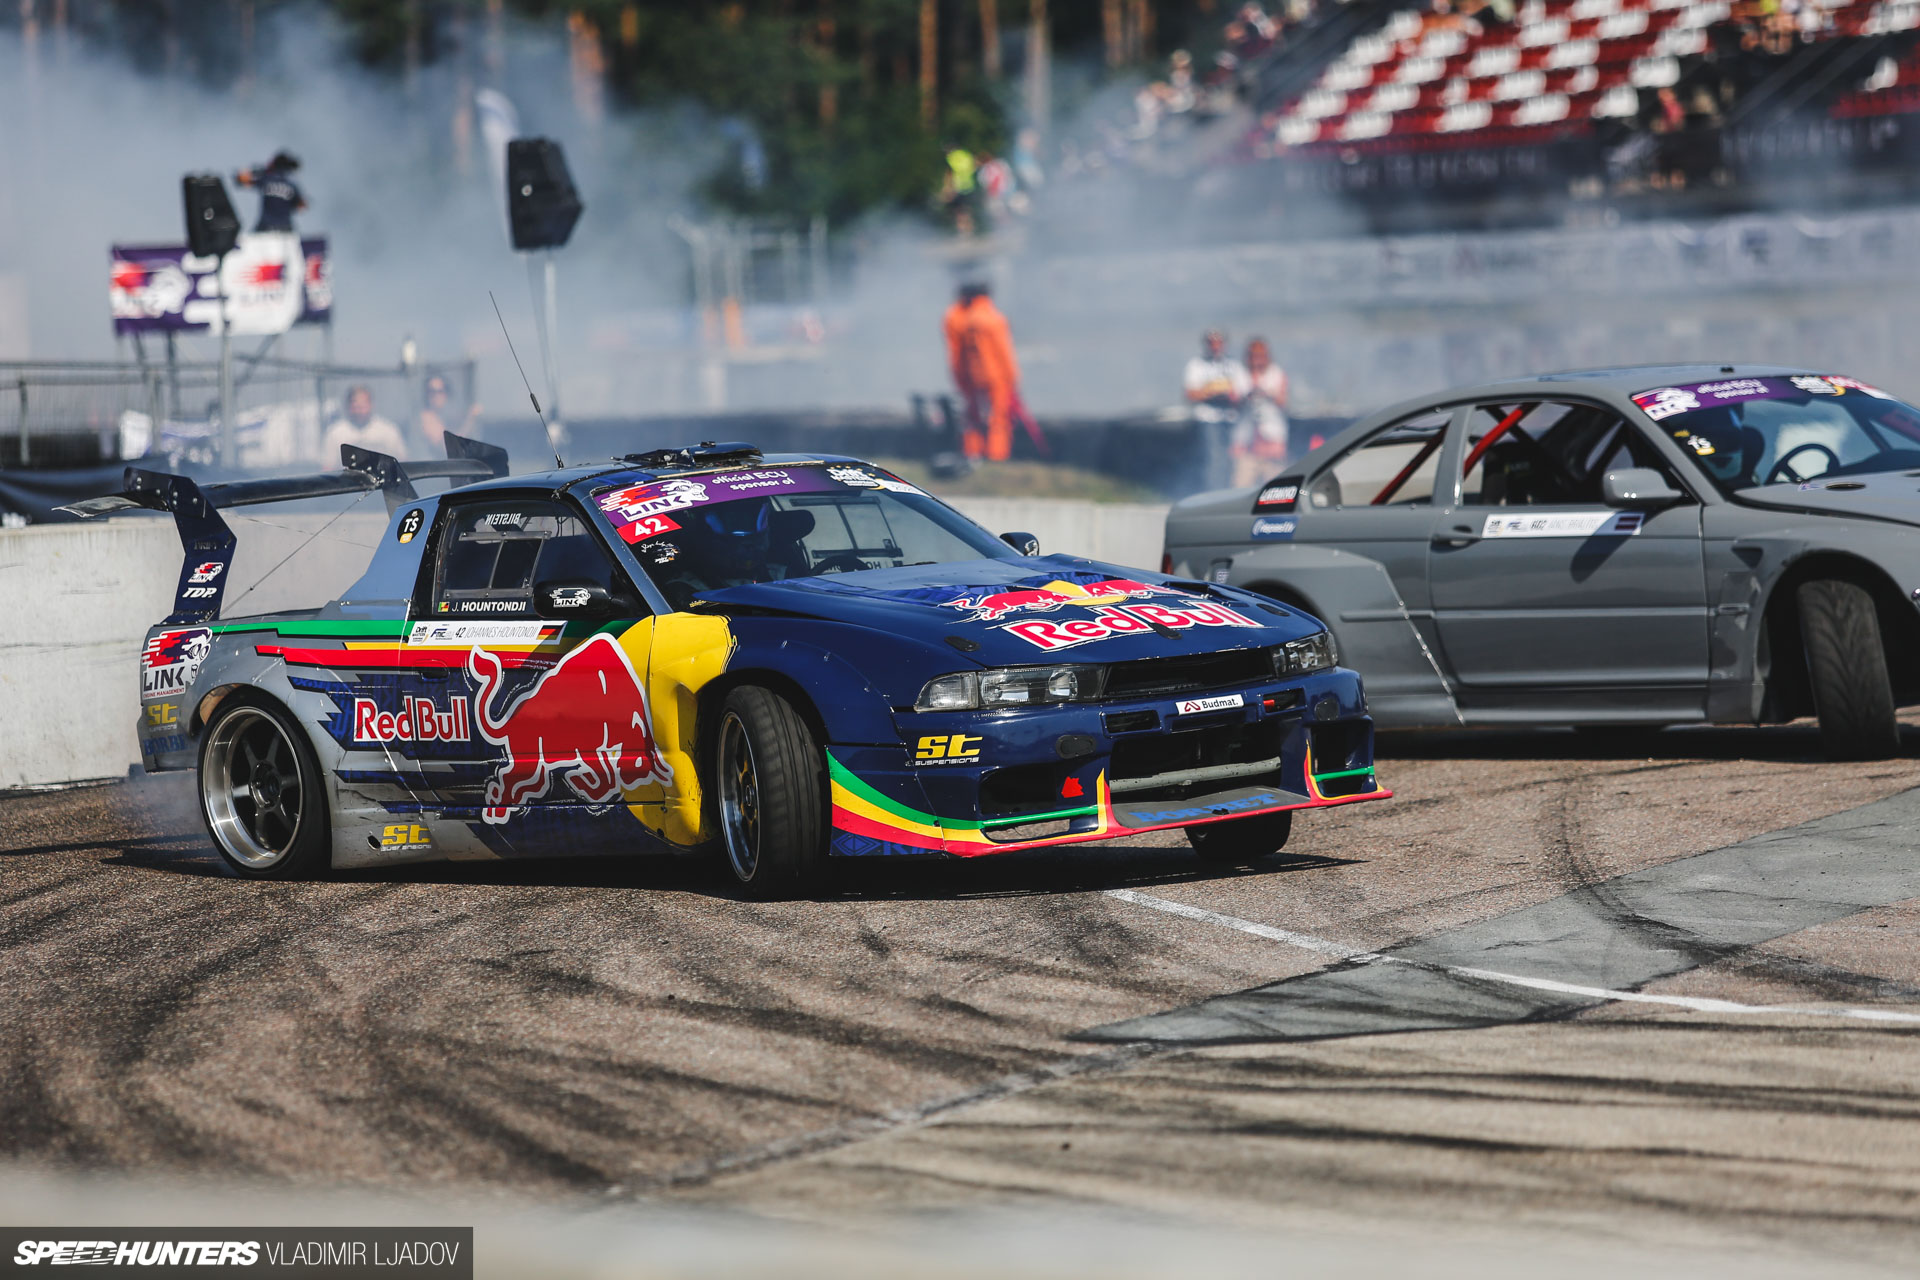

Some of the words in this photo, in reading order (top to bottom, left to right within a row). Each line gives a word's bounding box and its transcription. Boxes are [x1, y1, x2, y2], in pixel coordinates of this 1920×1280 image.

[712, 473, 755, 485] official
[756, 470, 789, 480] ECU
[730, 480, 780, 491] sponsor
[782, 477, 796, 486] of
[621, 495, 683, 519] LINK
[403, 517, 420, 533] TS
[634, 517, 669, 537] 42
[452, 602, 460, 612] J.
[461, 600, 527, 612] HOUNTONDJI
[555, 600, 579, 608] LINK
[455, 626, 467, 639] 42
[143, 665, 186, 692] LINK
[157, 687, 186, 697] MANAGEMENT
[1128, 793, 1279, 823] BORBET
